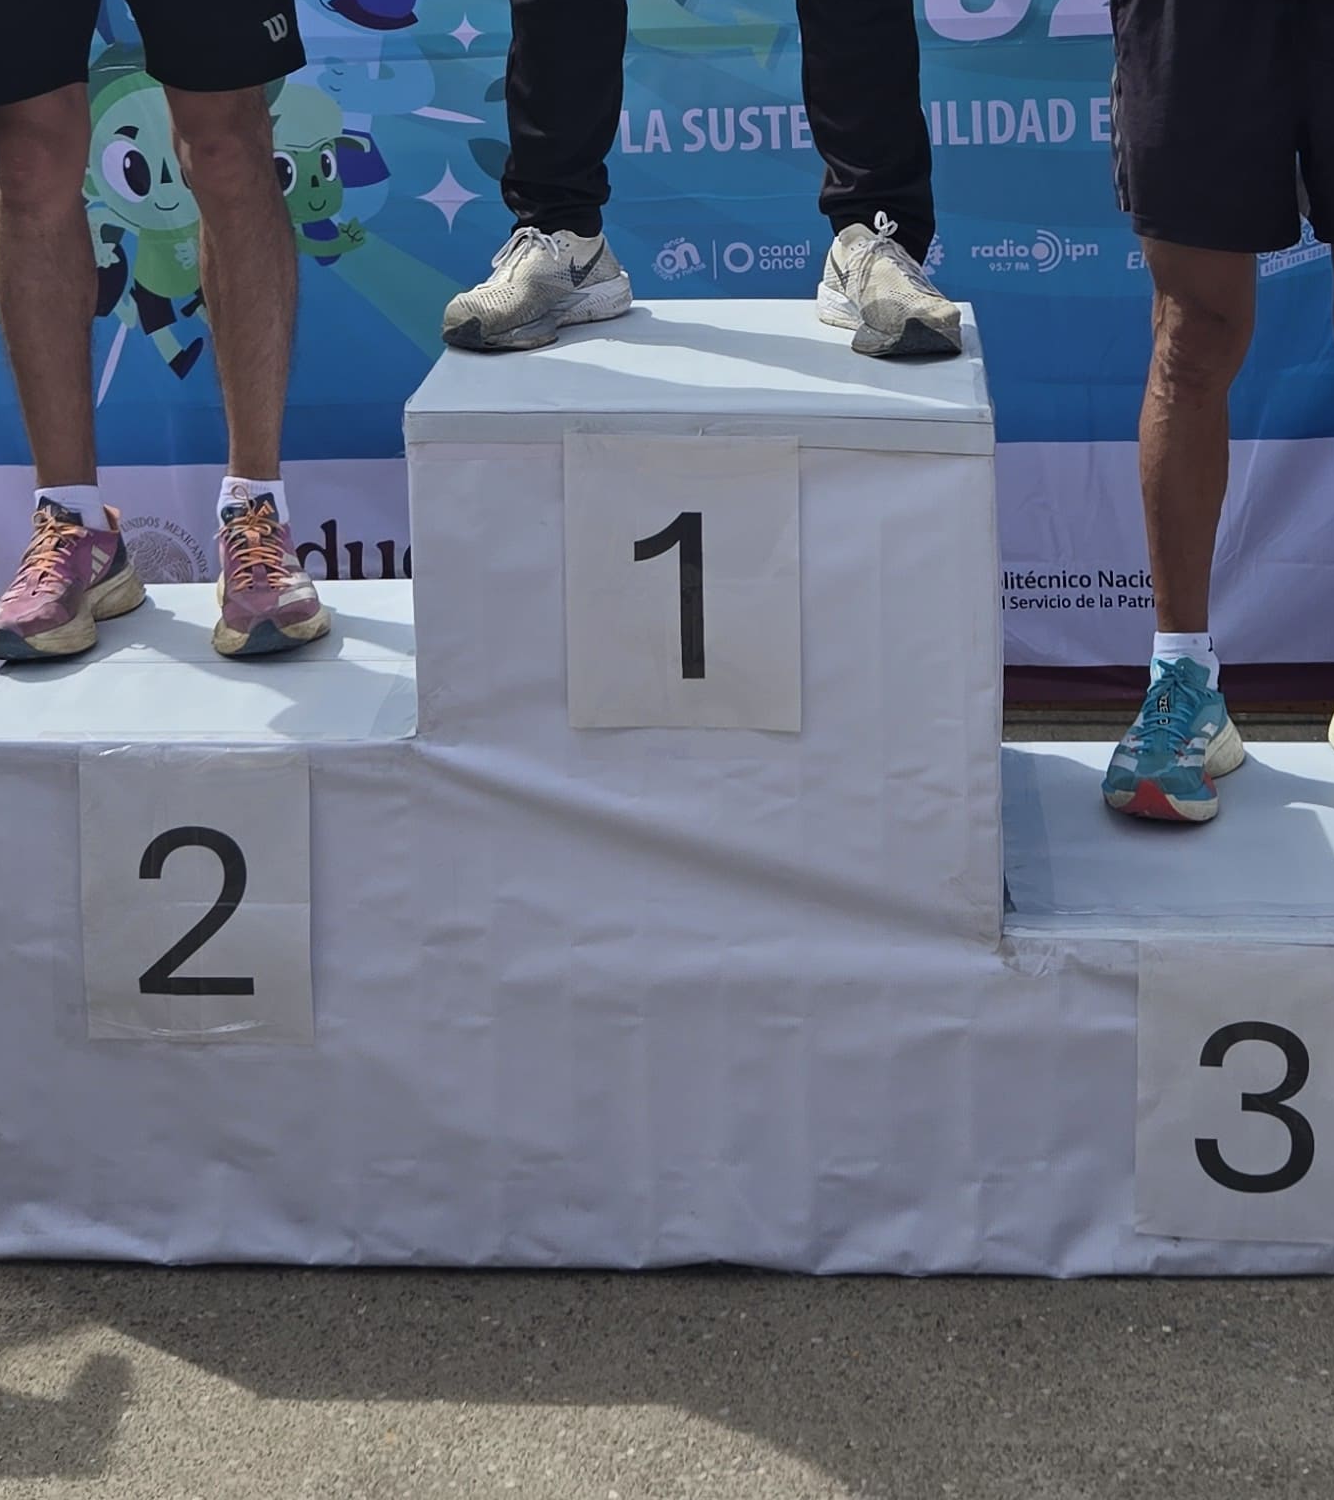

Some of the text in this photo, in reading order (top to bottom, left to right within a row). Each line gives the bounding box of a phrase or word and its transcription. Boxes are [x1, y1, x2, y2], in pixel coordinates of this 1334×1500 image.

[620, 109, 672, 154] LA
[758, 240, 811, 258] canal
[971, 238, 1099, 263] radio ipn
[759, 254, 807, 271] once
[988, 260, 1030, 272] 95.7 FM
[162, 515, 210, 574] MEXICANOS
[1001, 569, 1092, 590] litécnico
[633, 511, 705, 680] 1
[1010, 595, 1069, 610] Servicio
[1076, 594, 1096, 609] de
[1099, 594, 1114, 608] la
[137, 825, 256, 999] 2
[1194, 1020, 1316, 1196] 3
